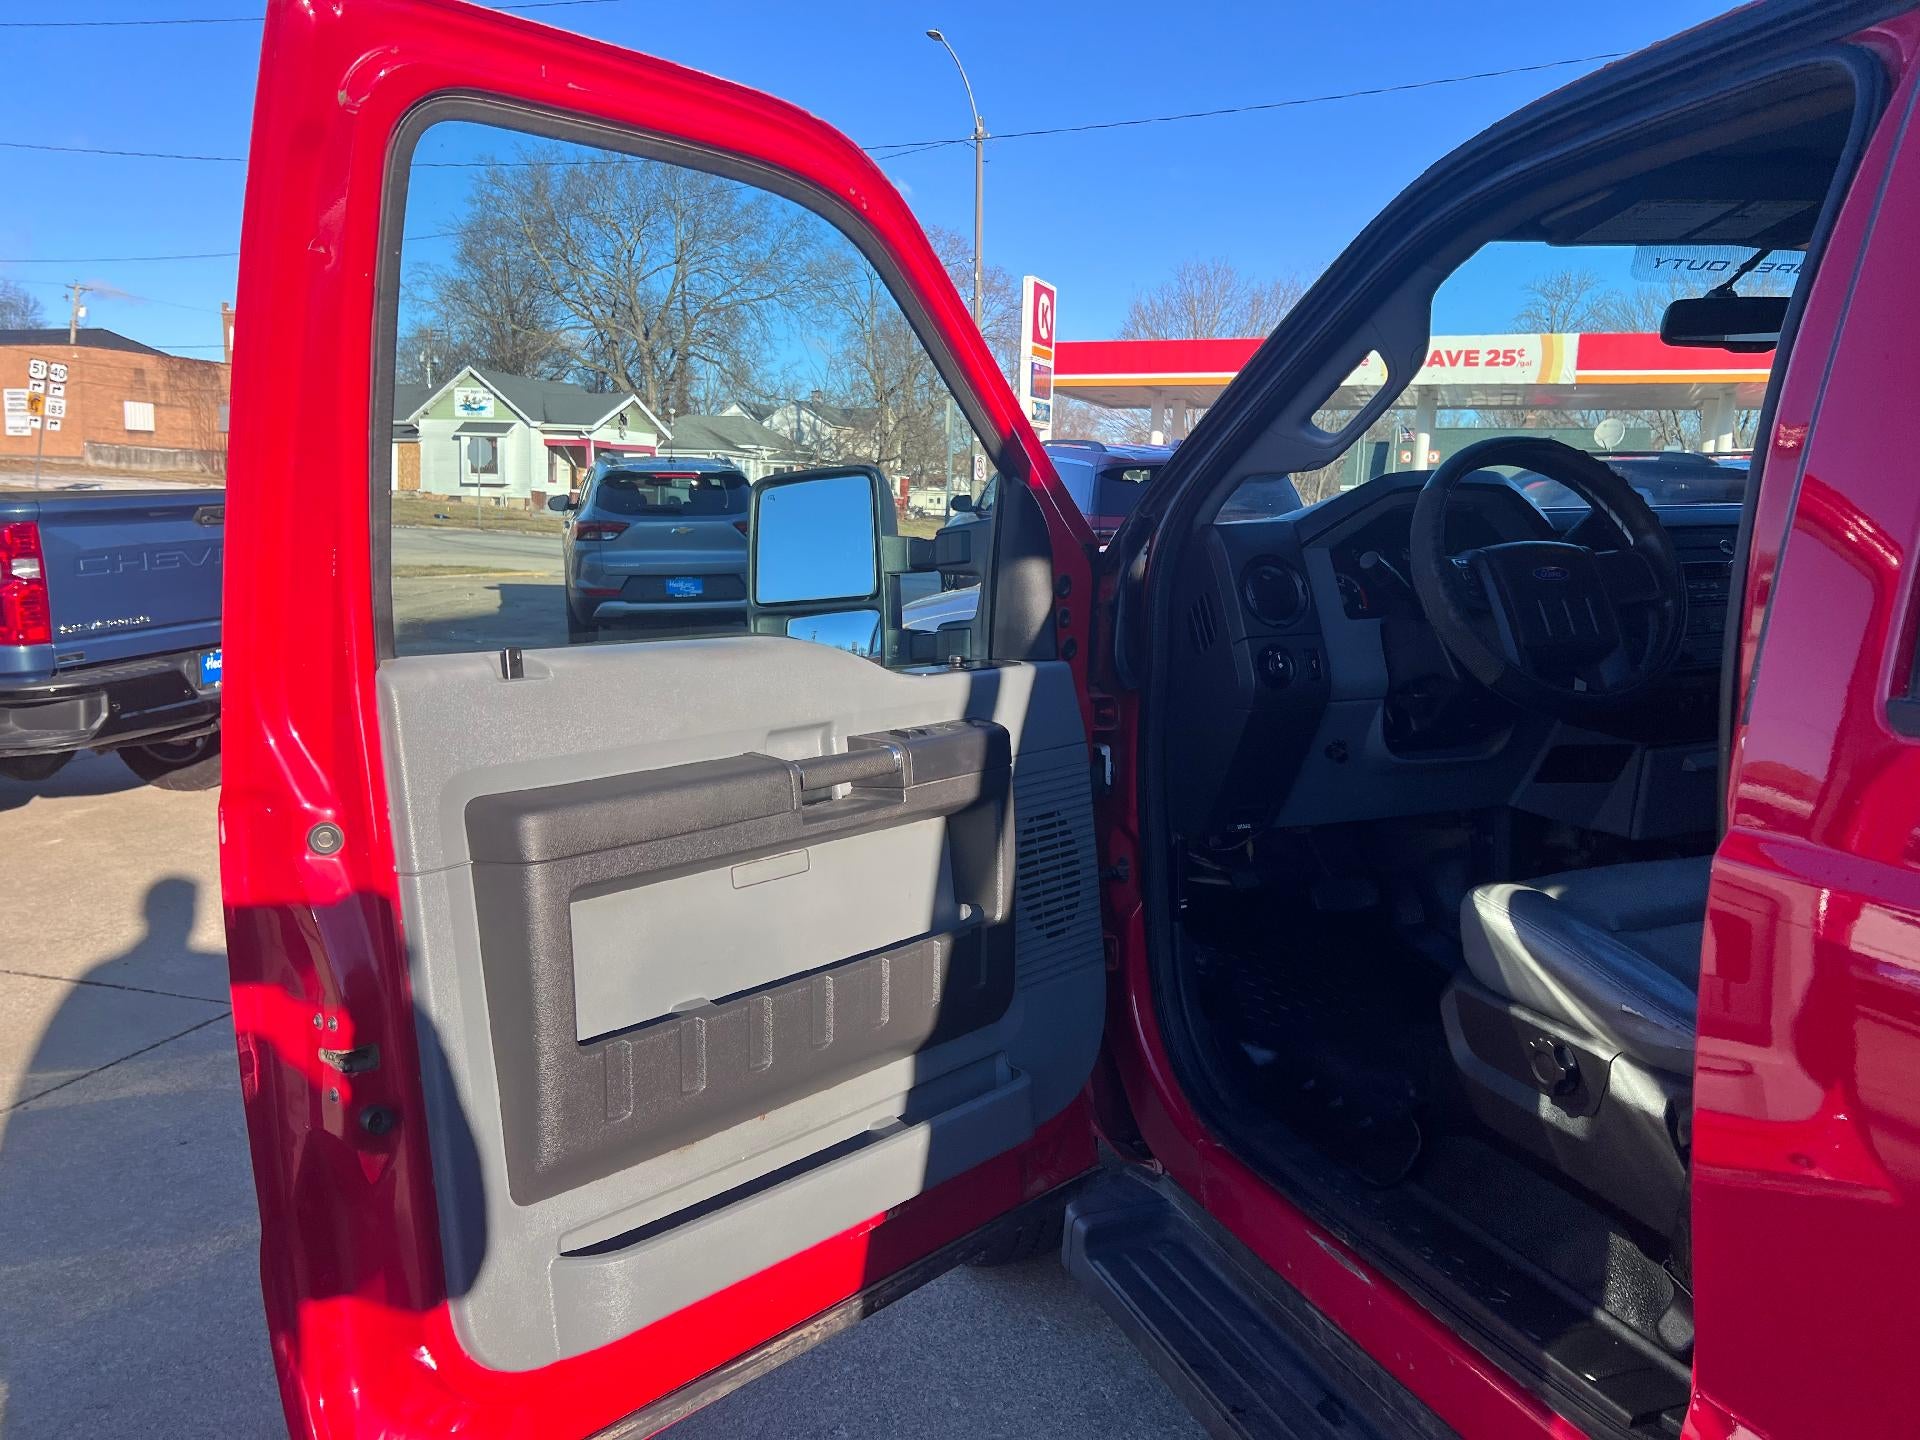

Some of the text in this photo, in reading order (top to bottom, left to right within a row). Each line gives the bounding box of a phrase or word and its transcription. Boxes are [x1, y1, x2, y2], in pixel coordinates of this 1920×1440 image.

[1041, 302, 1051, 334] K
[1423, 349, 1479, 367] AVE
[32, 362, 45, 375] 51
[50, 367, 66, 379] 40
[48, 404, 64, 415] 185
